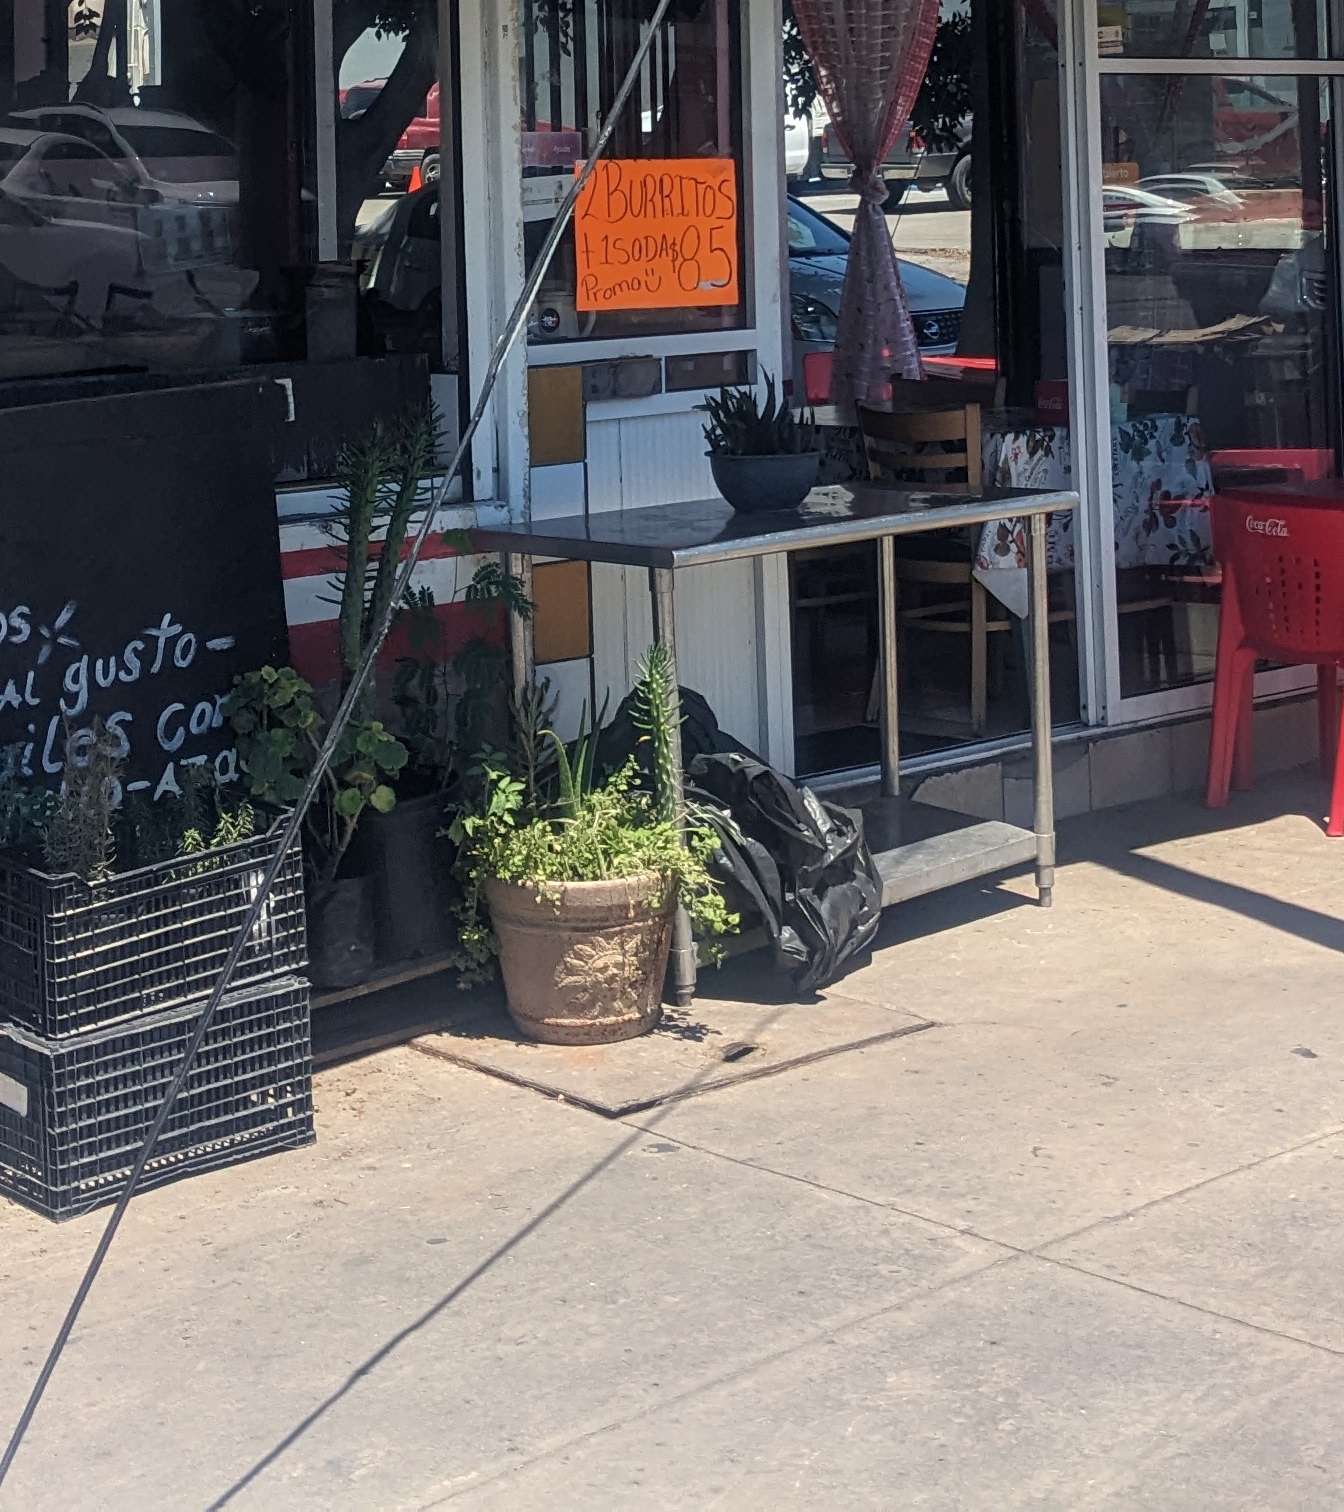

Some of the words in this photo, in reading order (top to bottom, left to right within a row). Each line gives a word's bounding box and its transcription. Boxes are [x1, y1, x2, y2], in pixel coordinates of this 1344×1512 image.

[581, 167, 599, 221] 2
[602, 160, 735, 224] BURRITOS
[581, 273, 642, 302] Promo
